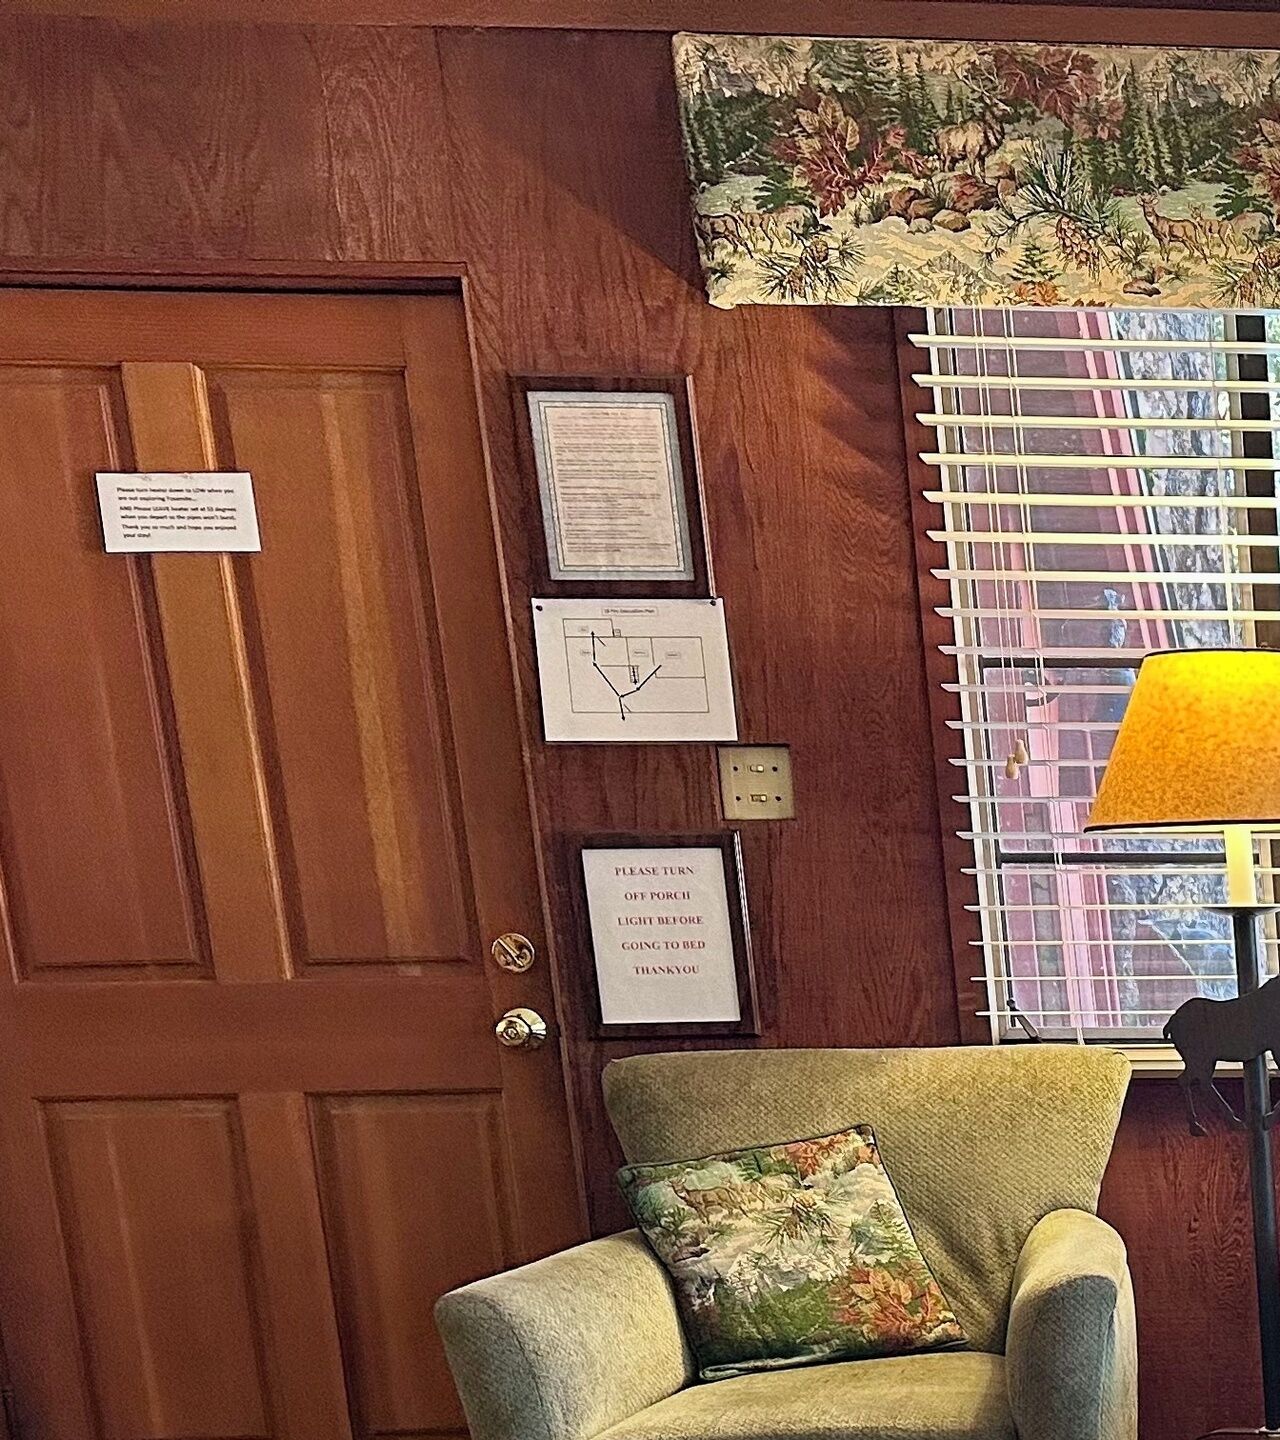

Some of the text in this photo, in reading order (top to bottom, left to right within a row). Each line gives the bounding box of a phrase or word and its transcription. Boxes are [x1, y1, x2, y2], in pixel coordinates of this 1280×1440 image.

[615, 866, 695, 876] PLEASE TURN
[624, 891, 691, 901] OFF PORCH
[617, 915, 705, 926] LIGHT BEFORE
[621, 940, 706, 951] GOING TO BED
[633, 965, 700, 976] THANKYOU
